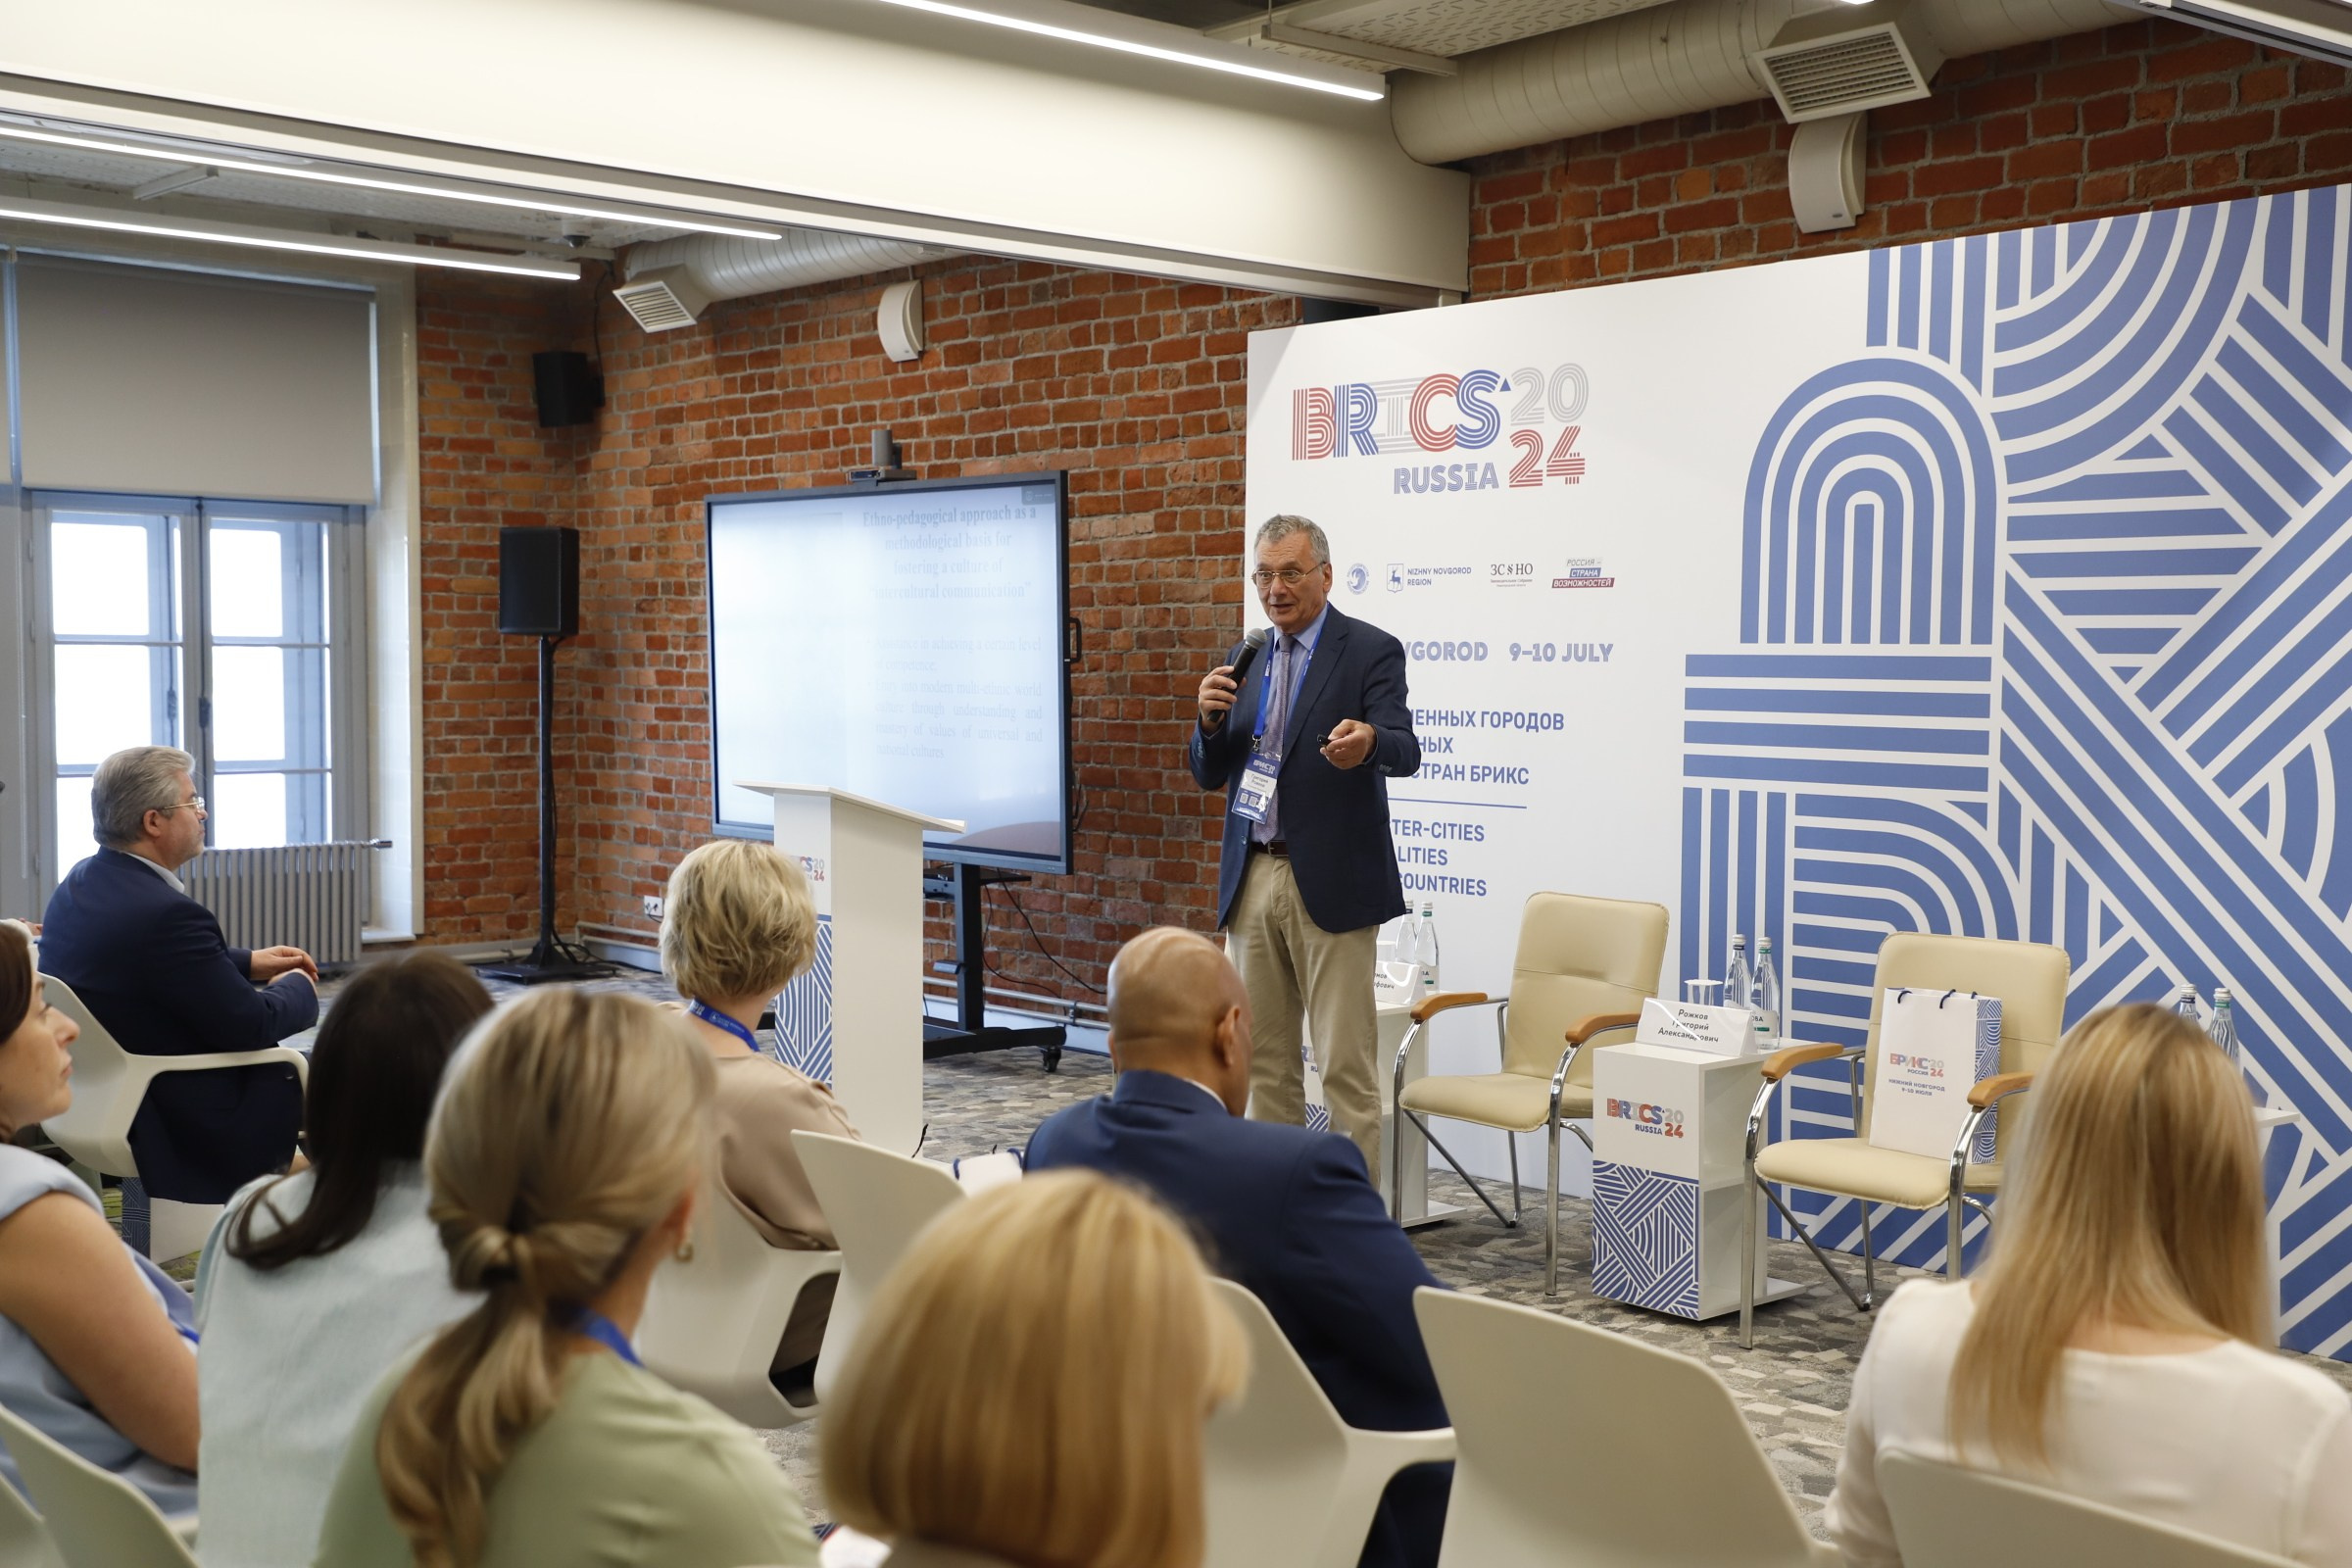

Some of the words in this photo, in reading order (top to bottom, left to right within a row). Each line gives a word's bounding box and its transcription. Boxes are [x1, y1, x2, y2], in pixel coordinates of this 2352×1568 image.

[1510, 363, 1589, 426] 20
[1292, 369, 1501, 461] BRICS
[1509, 425, 1586, 488] 24
[1394, 463, 1499, 494] RUSSIA
[862, 507, 957, 529] Ethno-pedagogical
[959, 505, 1012, 526] approach
[1014, 508, 1027, 519] as
[1030, 508, 1036, 518] a
[885, 533, 962, 552] methodological
[965, 532, 992, 547] basis
[996, 530, 1011, 546] for
[894, 560, 940, 577] fostering
[942, 563, 948, 573] a
[951, 559, 989, 573] culture
[992, 557, 1004, 572] of
[1553, 578, 1612, 588] ВОЗМОЖНОСТЕЙ
[1018, 636, 1042, 652] level
[1561, 643, 1614, 662] JULY
[1014, 682, 1042, 697] world
[911, 699, 945, 718] through
[954, 703, 1016, 721] understanding
[1025, 706, 1043, 719] and
[913, 721, 925, 736] of
[962, 725, 973, 738] of
[1025, 728, 1043, 742] and
[1481, 710, 1564, 733] ГОРОДОВ
[1411, 762, 1466, 781] ТРАН
[1470, 765, 1530, 785] БРИКС
[1392, 818, 1485, 842] TER-CITIES
[1397, 846, 1447, 865] LITIES
[1398, 872, 1487, 897] OUNTRIES
[1374, 981, 1395, 990] фович
[1678, 1008, 1709, 1020] Рожков
[1930, 1068, 1944, 1078] 24
[1914, 1083, 1945, 1092] НОВГОРОД
[1607, 1098, 1663, 1125] BRICS
[1665, 1107, 1685, 1124] 20
[1635, 1124, 1663, 1135] RUSSIA
[1665, 1122, 1684, 1139] 24
